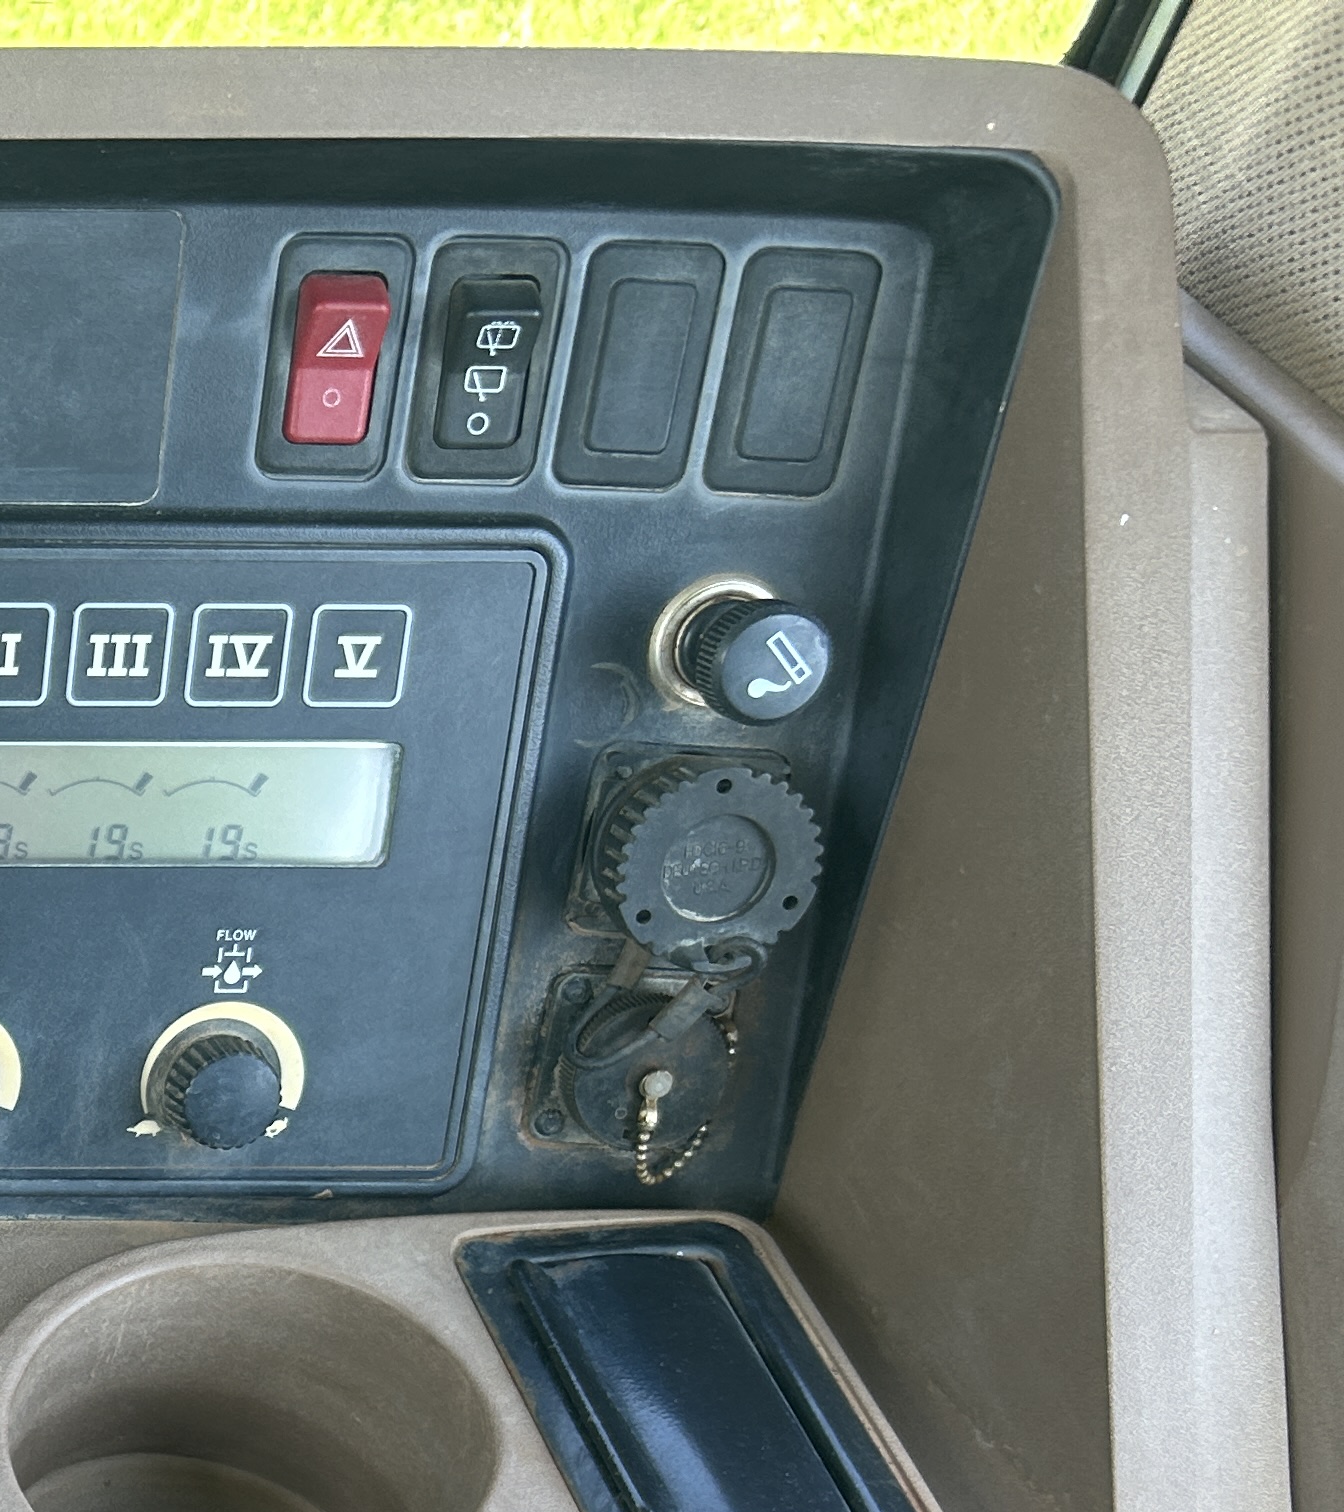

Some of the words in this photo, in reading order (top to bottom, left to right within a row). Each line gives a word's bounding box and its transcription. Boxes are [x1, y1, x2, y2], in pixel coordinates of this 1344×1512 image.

[87, 635, 152, 676] III
[206, 635, 273, 677] IV
[334, 636, 382, 678] V
[216, 930, 257, 941] FLOW
